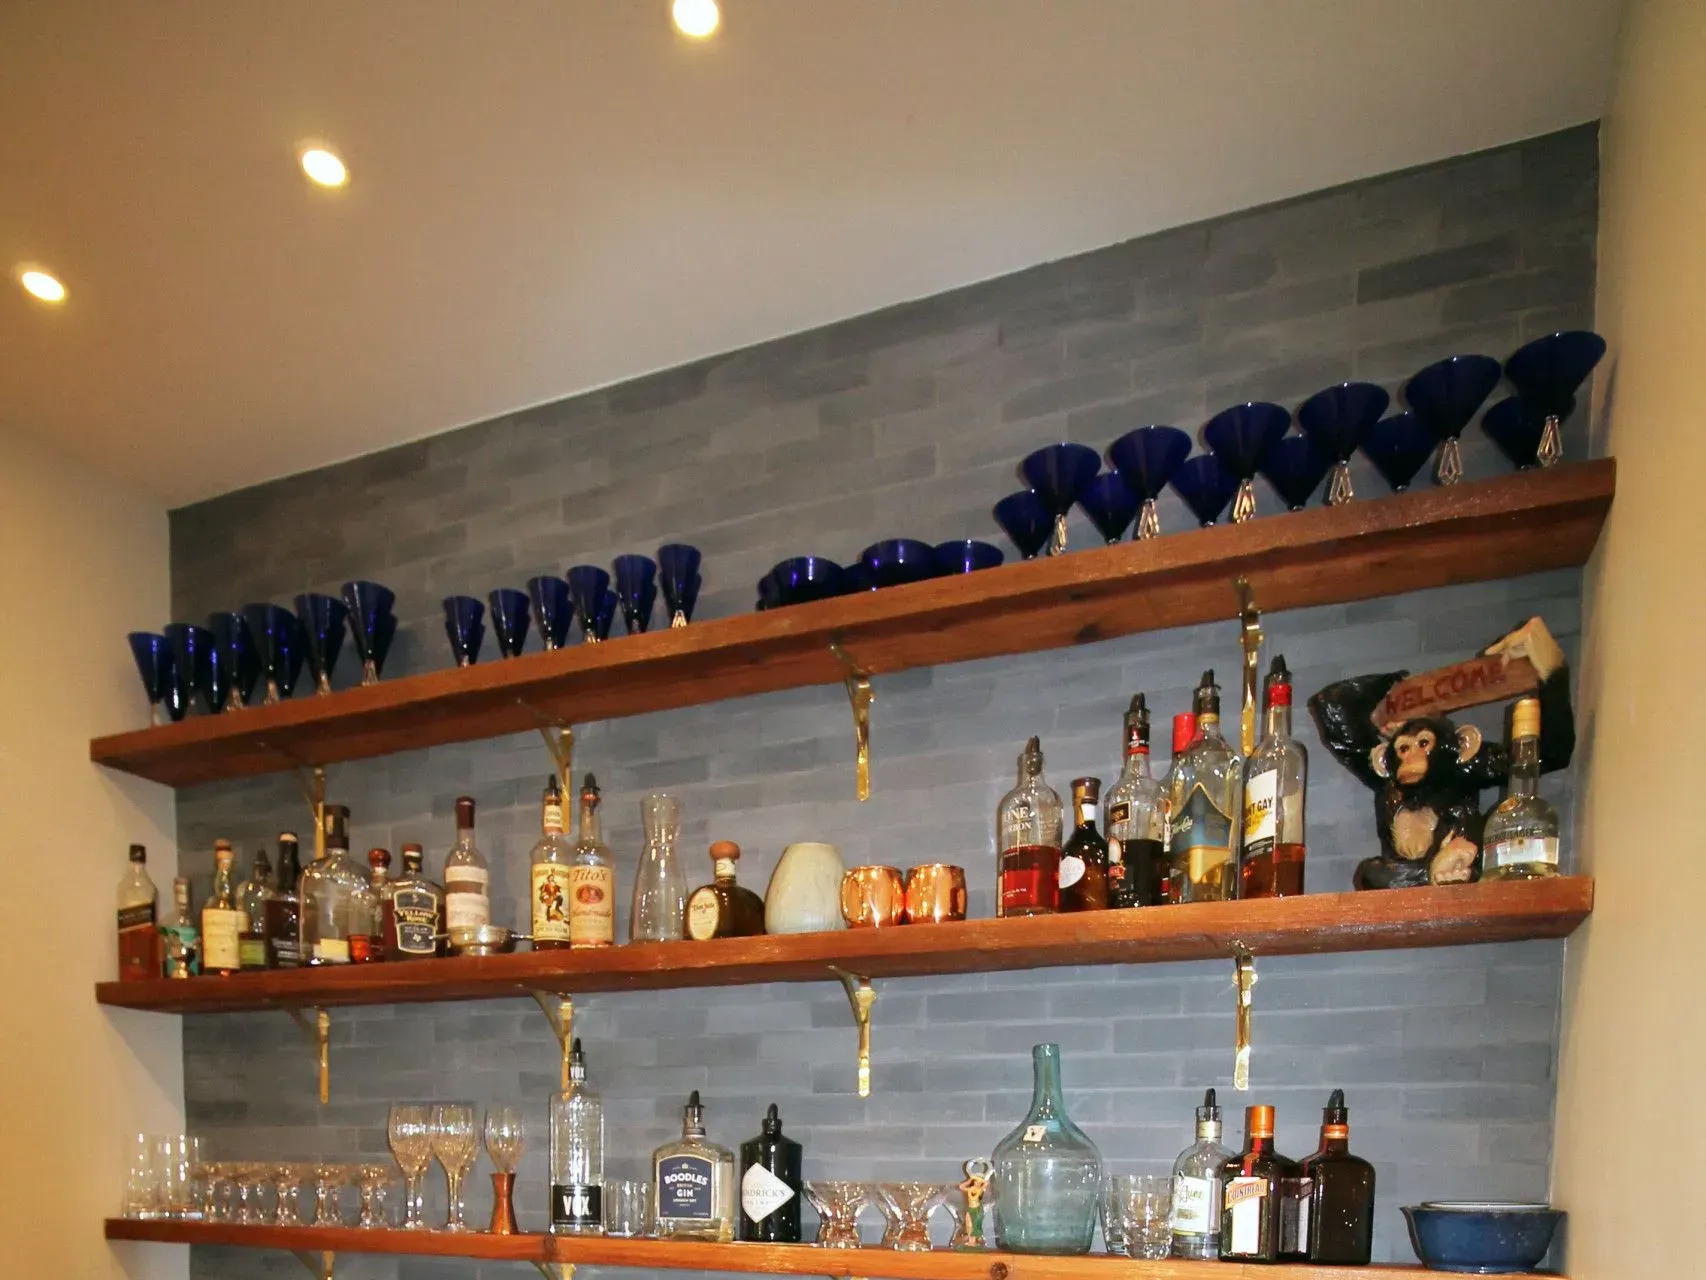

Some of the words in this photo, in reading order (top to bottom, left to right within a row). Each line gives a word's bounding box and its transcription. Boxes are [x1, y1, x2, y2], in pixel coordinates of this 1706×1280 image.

[1385, 662, 1507, 715] WELCOME
[1257, 797, 1273, 811] GAY
[572, 869, 608, 883] Tito's
[569, 1065, 585, 1079] VOX
[664, 1172, 709, 1186] BOODLES
[676, 1189, 694, 1198] GIN
[562, 1195, 590, 1217] VOX
